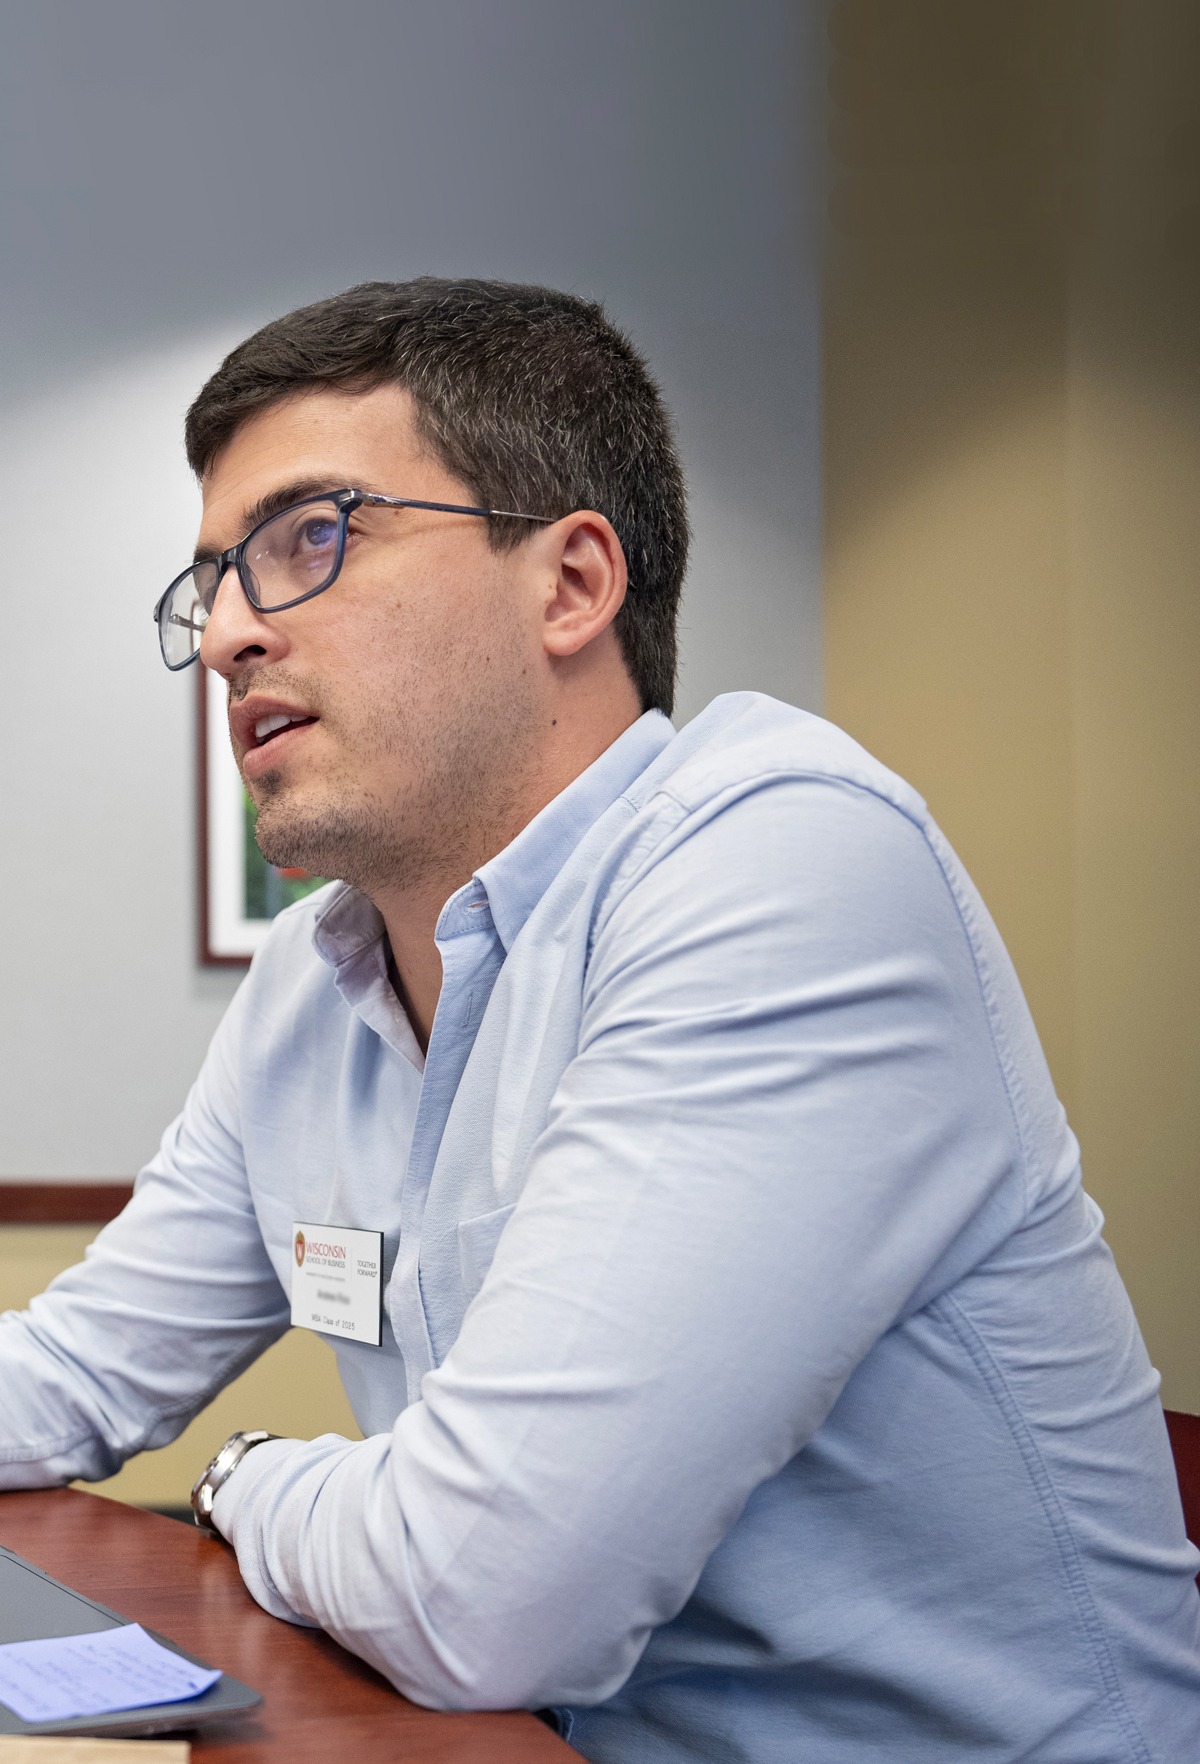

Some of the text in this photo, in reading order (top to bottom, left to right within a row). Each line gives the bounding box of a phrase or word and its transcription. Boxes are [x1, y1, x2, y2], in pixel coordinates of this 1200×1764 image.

[306, 1241, 346, 1259] WISCONSIN
[306, 1256, 321, 1264] SCHOOL
[328, 1259, 346, 1268] BUSINESS
[357, 1260, 377, 1269] TOGETHER
[311, 1313, 321, 1322] MBA
[342, 1320, 355, 1330] 2025
